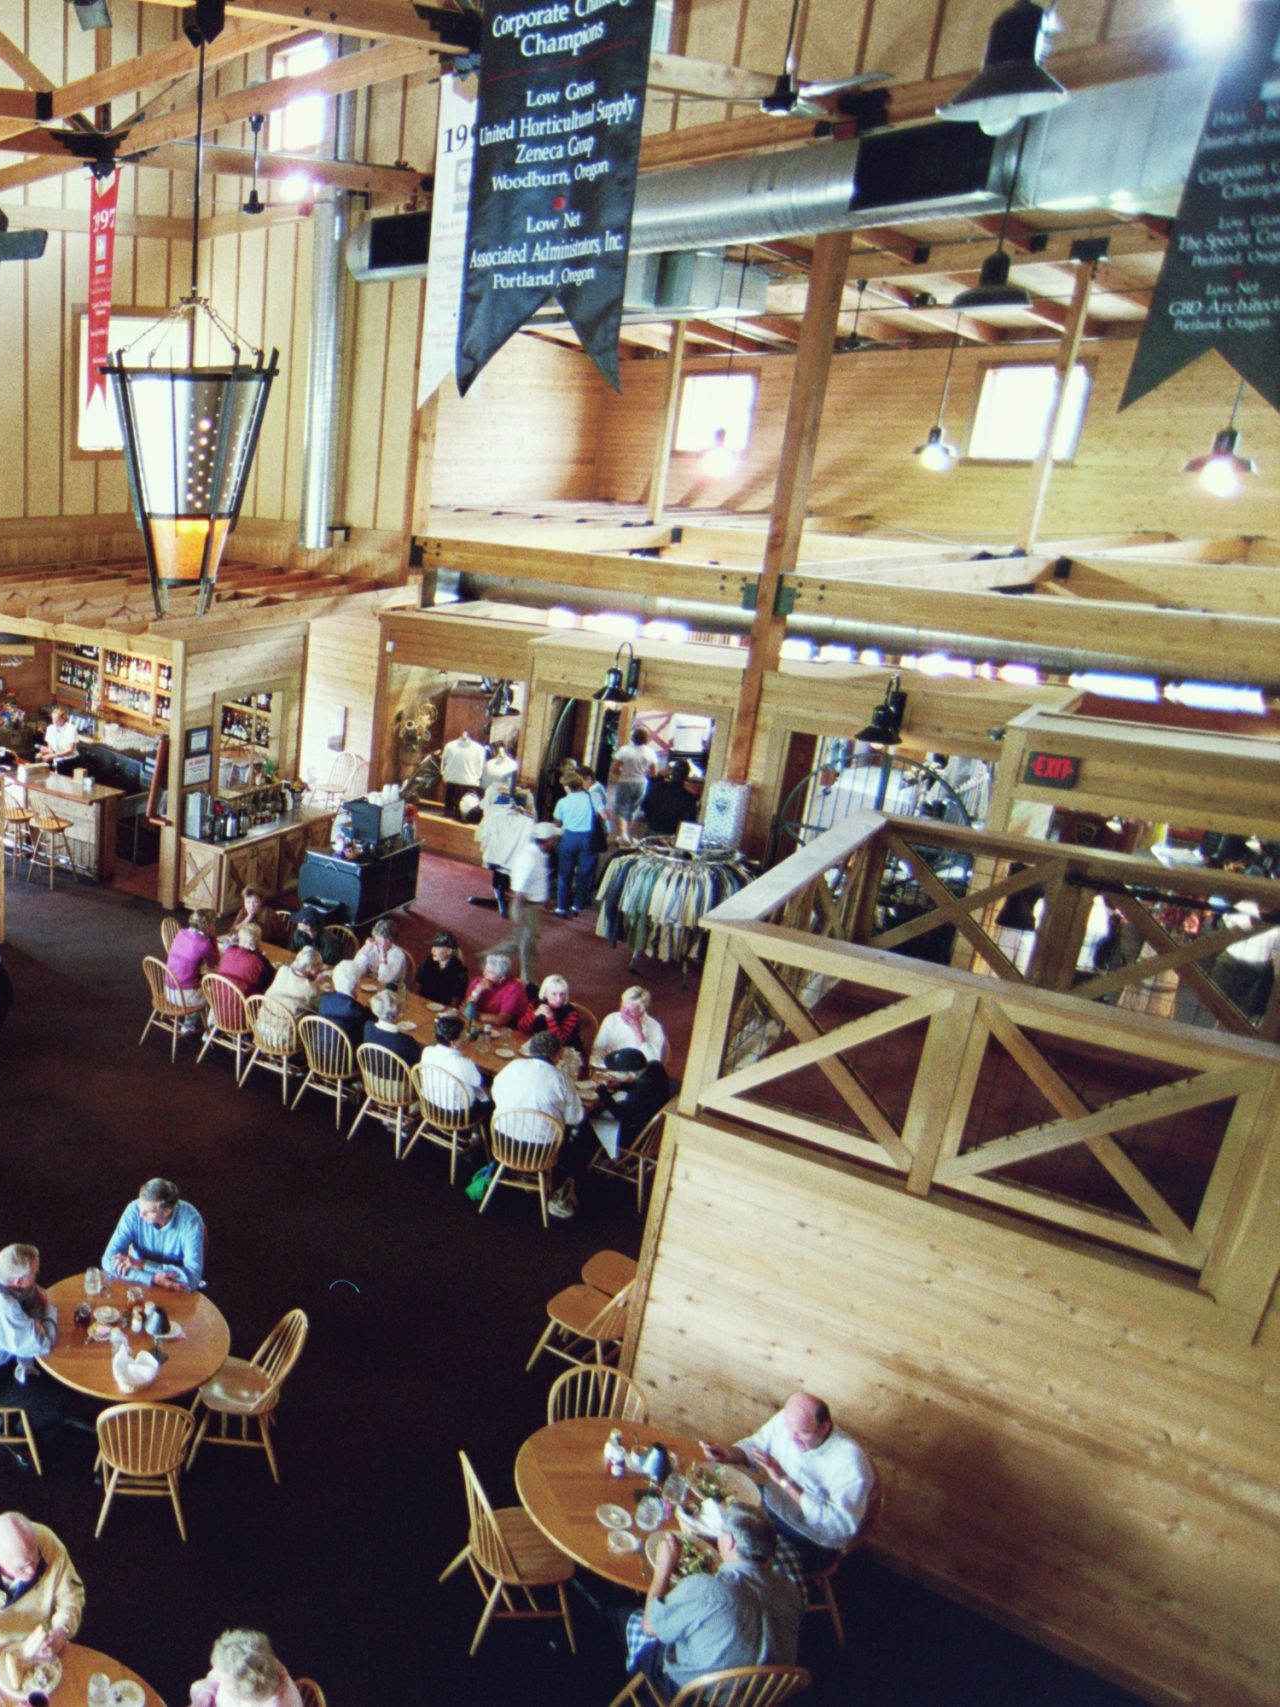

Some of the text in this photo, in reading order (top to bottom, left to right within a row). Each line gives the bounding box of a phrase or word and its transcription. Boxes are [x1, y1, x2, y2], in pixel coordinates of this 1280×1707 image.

[492, 4, 570, 39] Corporate
[520, 21, 605, 57] Champions
[525, 80, 595, 108] Low Gross
[479, 93, 637, 146] United Horticultural Supply
[515, 134, 595, 165] Zeneca Group
[491, 160, 609, 192] Woodburn, Oregon
[525, 211, 582, 233] Low Net
[468, 243, 528, 269] Associated
[531, 236, 602, 263] Administrators,
[604, 230, 624, 252] Inc.
[560, 268, 595, 286] Oregon
[1032, 755, 1072, 780] EXIT
